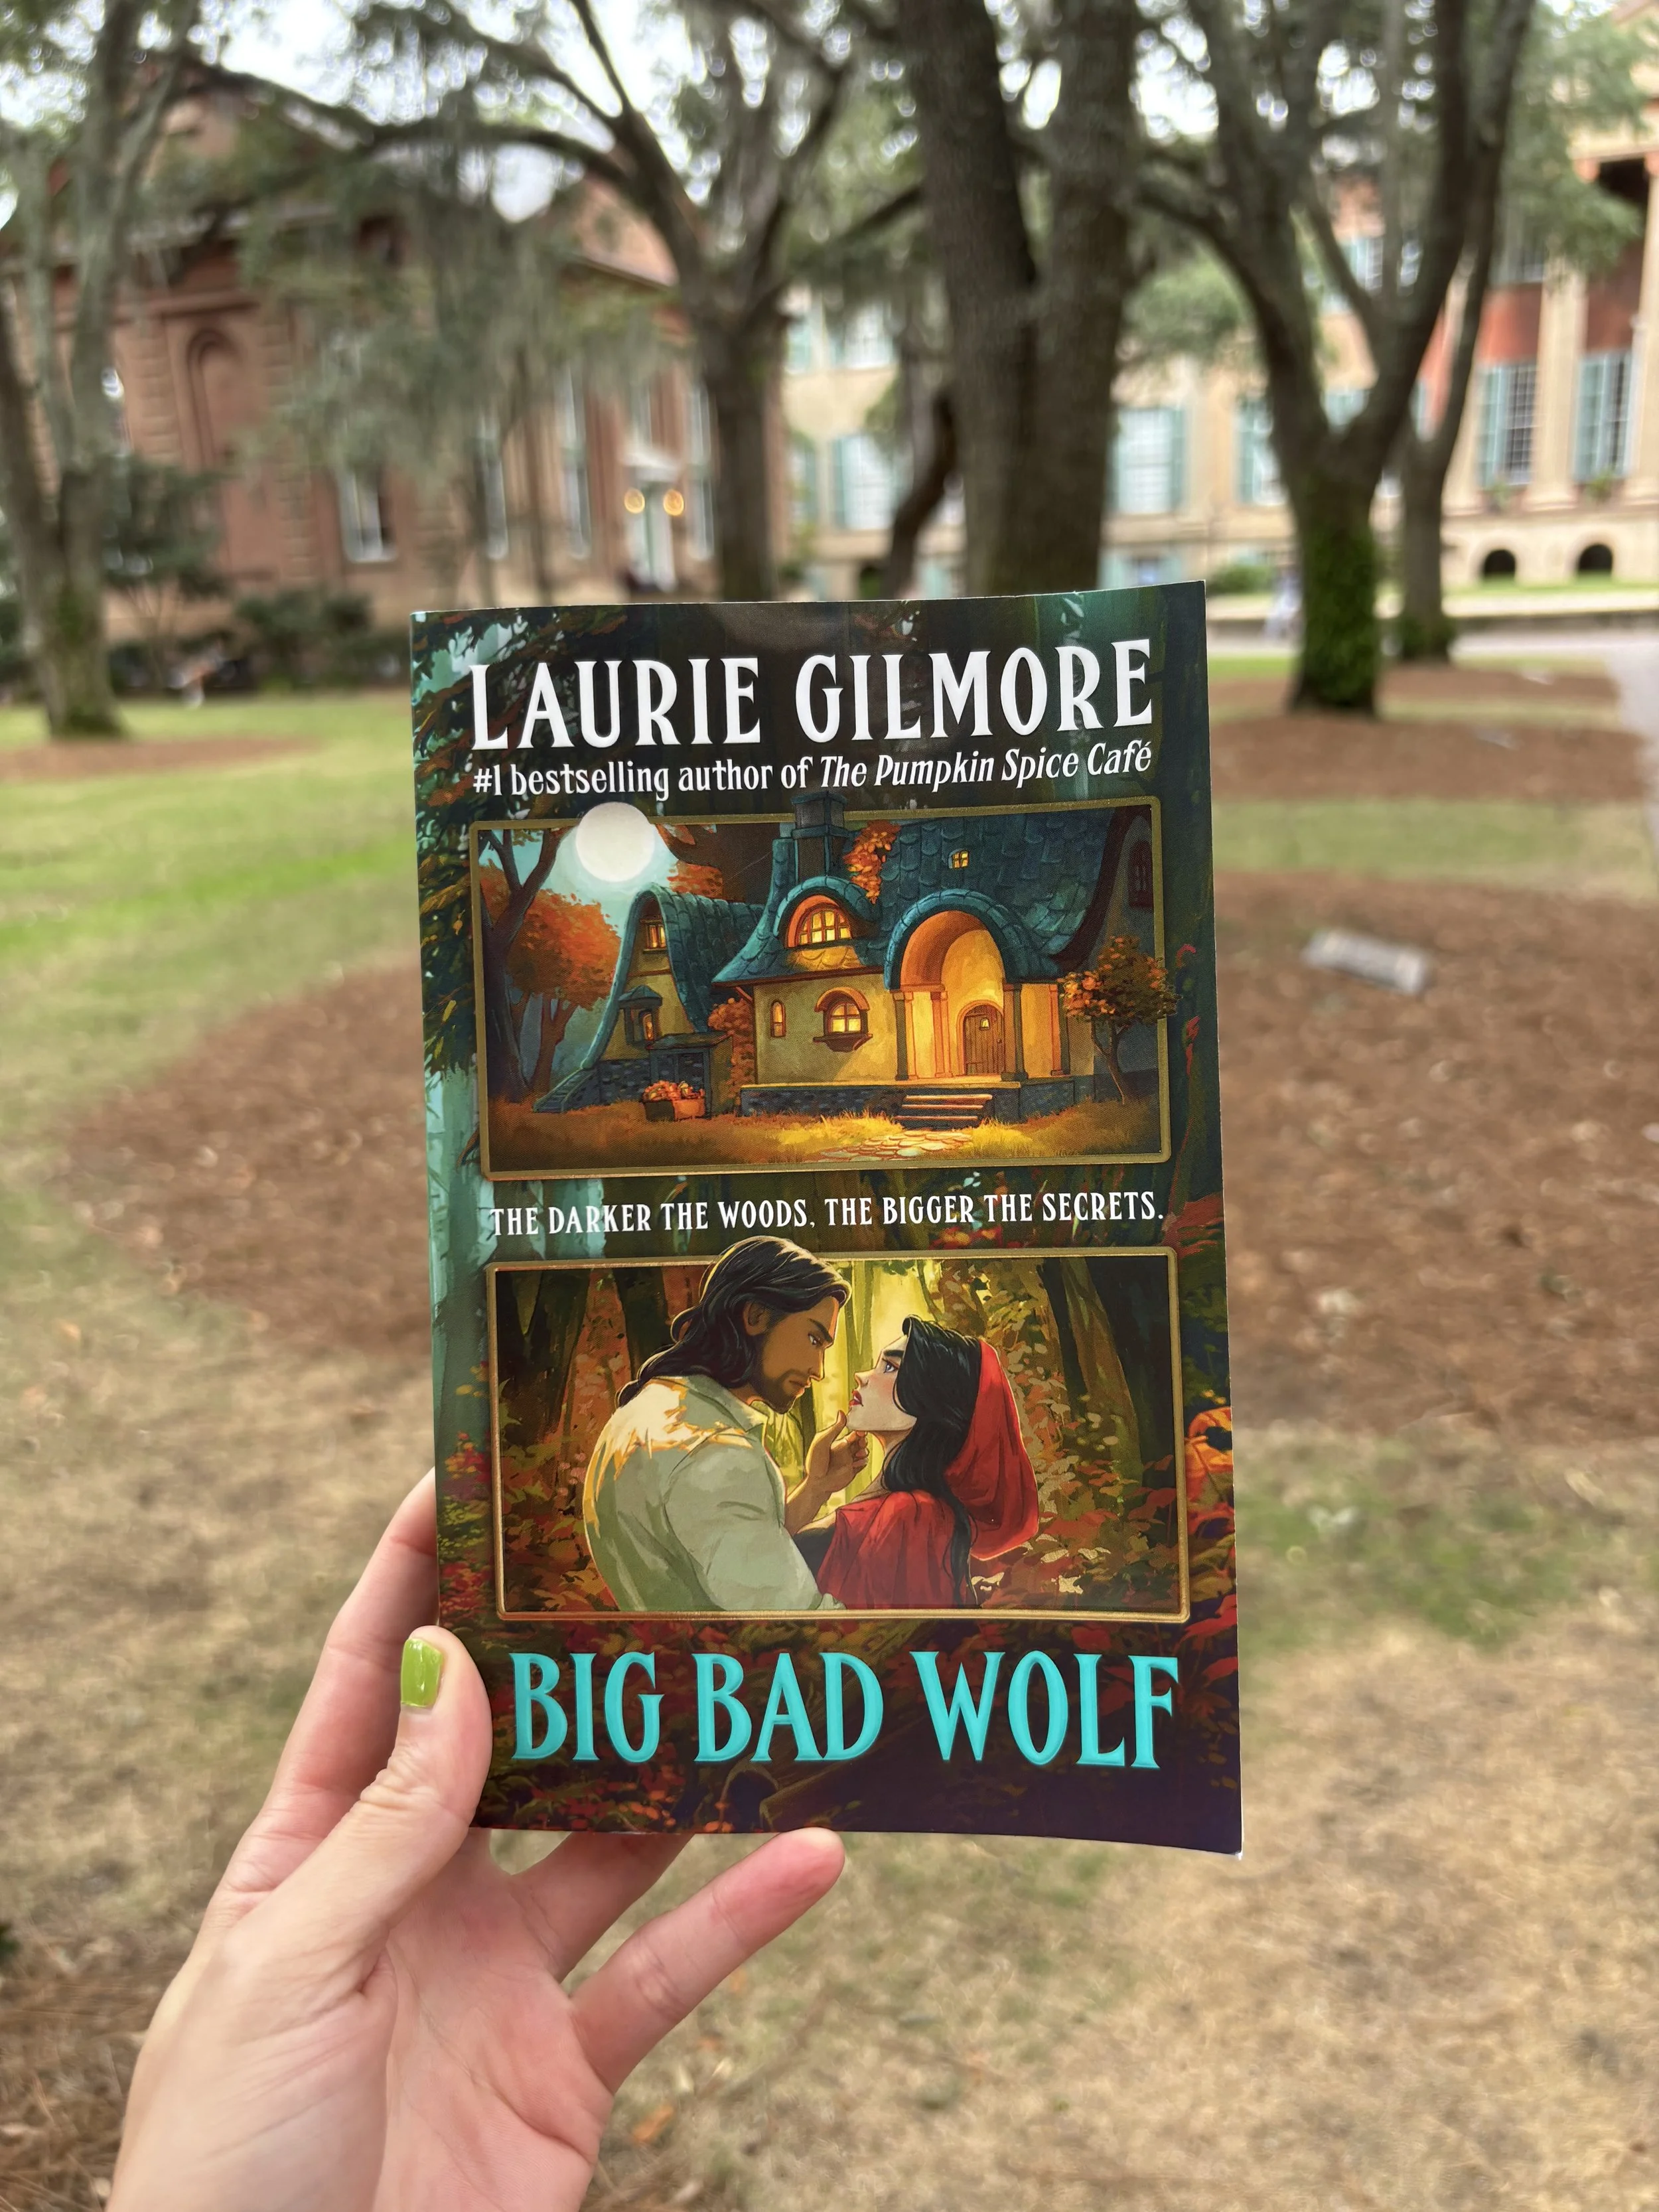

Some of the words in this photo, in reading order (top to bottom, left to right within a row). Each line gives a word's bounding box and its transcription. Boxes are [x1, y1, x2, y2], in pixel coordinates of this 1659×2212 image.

[470, 658, 761, 750] LAURIE
[795, 638, 1153, 743] GILMORE
[472, 763, 502, 796] #1
[510, 761, 669, 802] bestselling
[678, 759, 773, 791] author
[780, 756, 813, 789] of
[821, 755, 867, 788] The
[874, 751, 995, 793] Pumpkin
[1001, 747, 1079, 788] Spice
[1087, 739, 1152, 776] Café
[490, 1207, 540, 1236] THE
[548, 1203, 652, 1234] DARKER
[660, 1202, 709, 1230] THE
[717, 1199, 815, 1228] WOODS,
[824, 1197, 873, 1226] THE
[883, 1194, 975, 1224] BIGGER
[983, 1194, 1033, 1222] THE
[1043, 1191, 1164, 1221] SECRETS.
[510, 1652, 664, 1763] BIG
[692, 1652, 884, 1762] BAD
[910, 1651, 1179, 1769] WOLF
